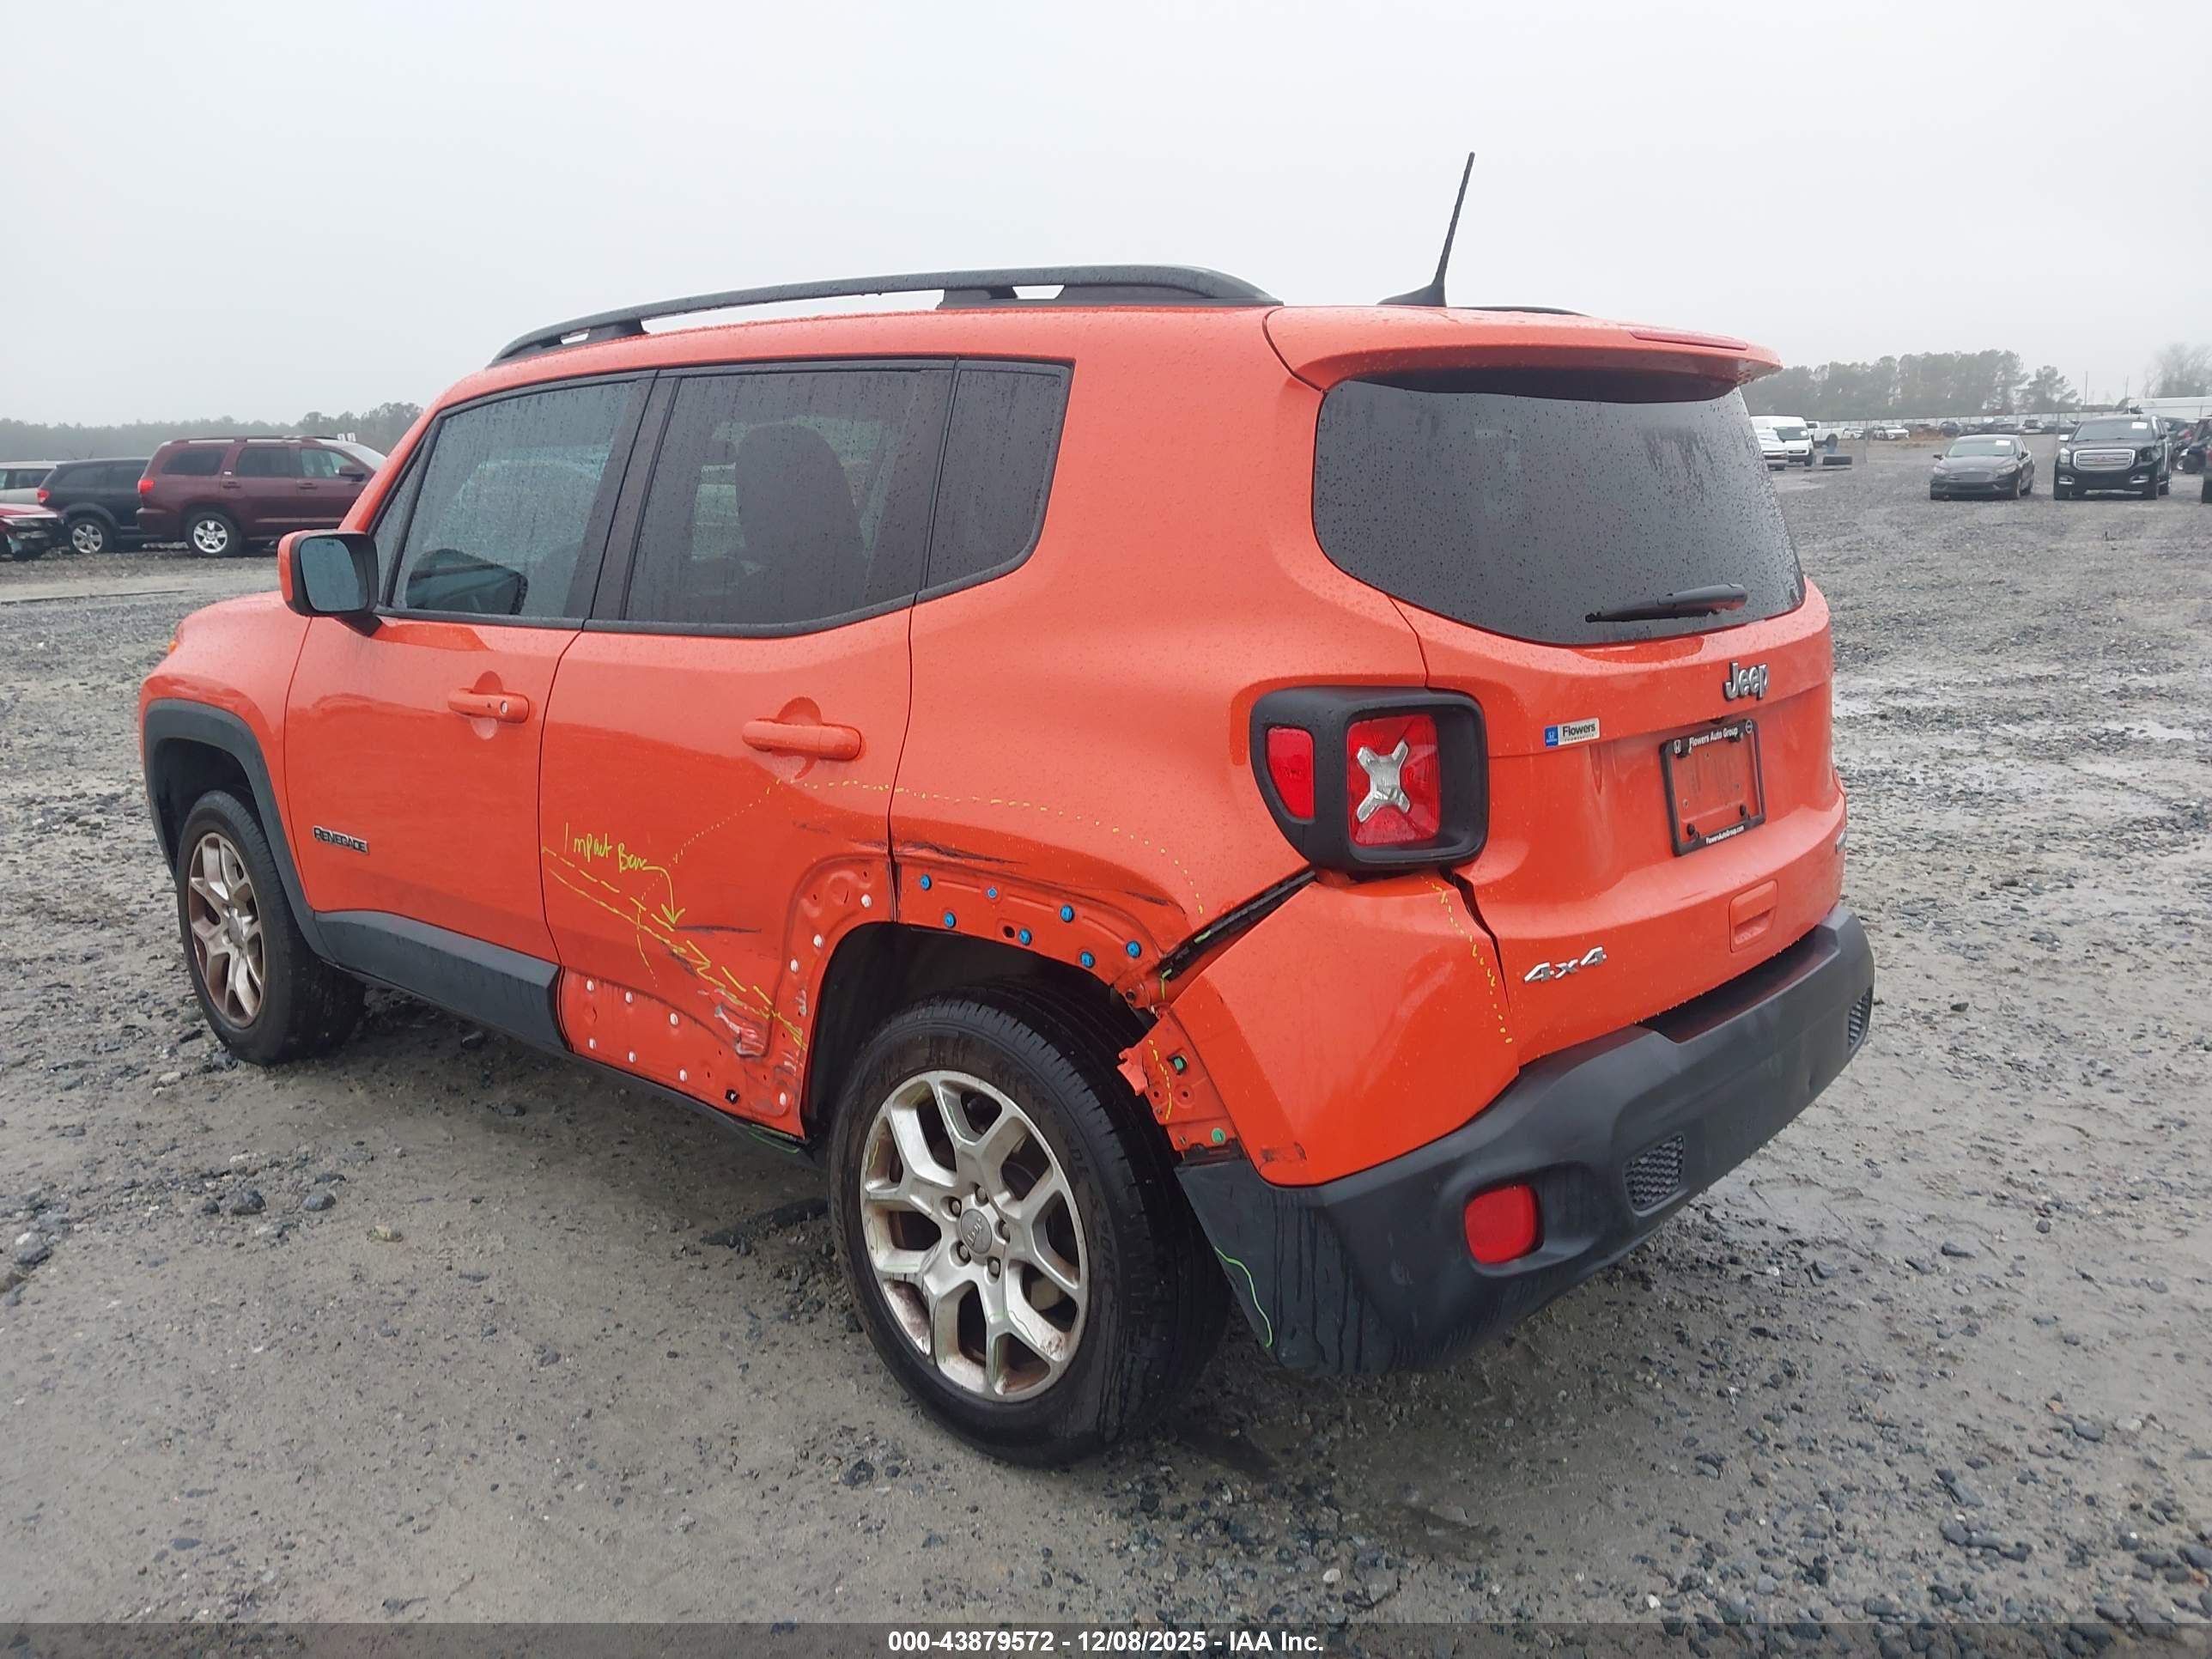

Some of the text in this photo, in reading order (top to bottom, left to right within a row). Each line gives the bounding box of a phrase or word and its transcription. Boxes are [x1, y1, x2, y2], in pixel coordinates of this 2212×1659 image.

[1723, 661, 1769, 701] Jeep
[1562, 723, 1596, 737] Flowers
[1689, 726, 1738, 747] Flowers Auto Group
[313, 825, 369, 853] RENEGADE
[1524, 946, 1607, 982] 4x4
